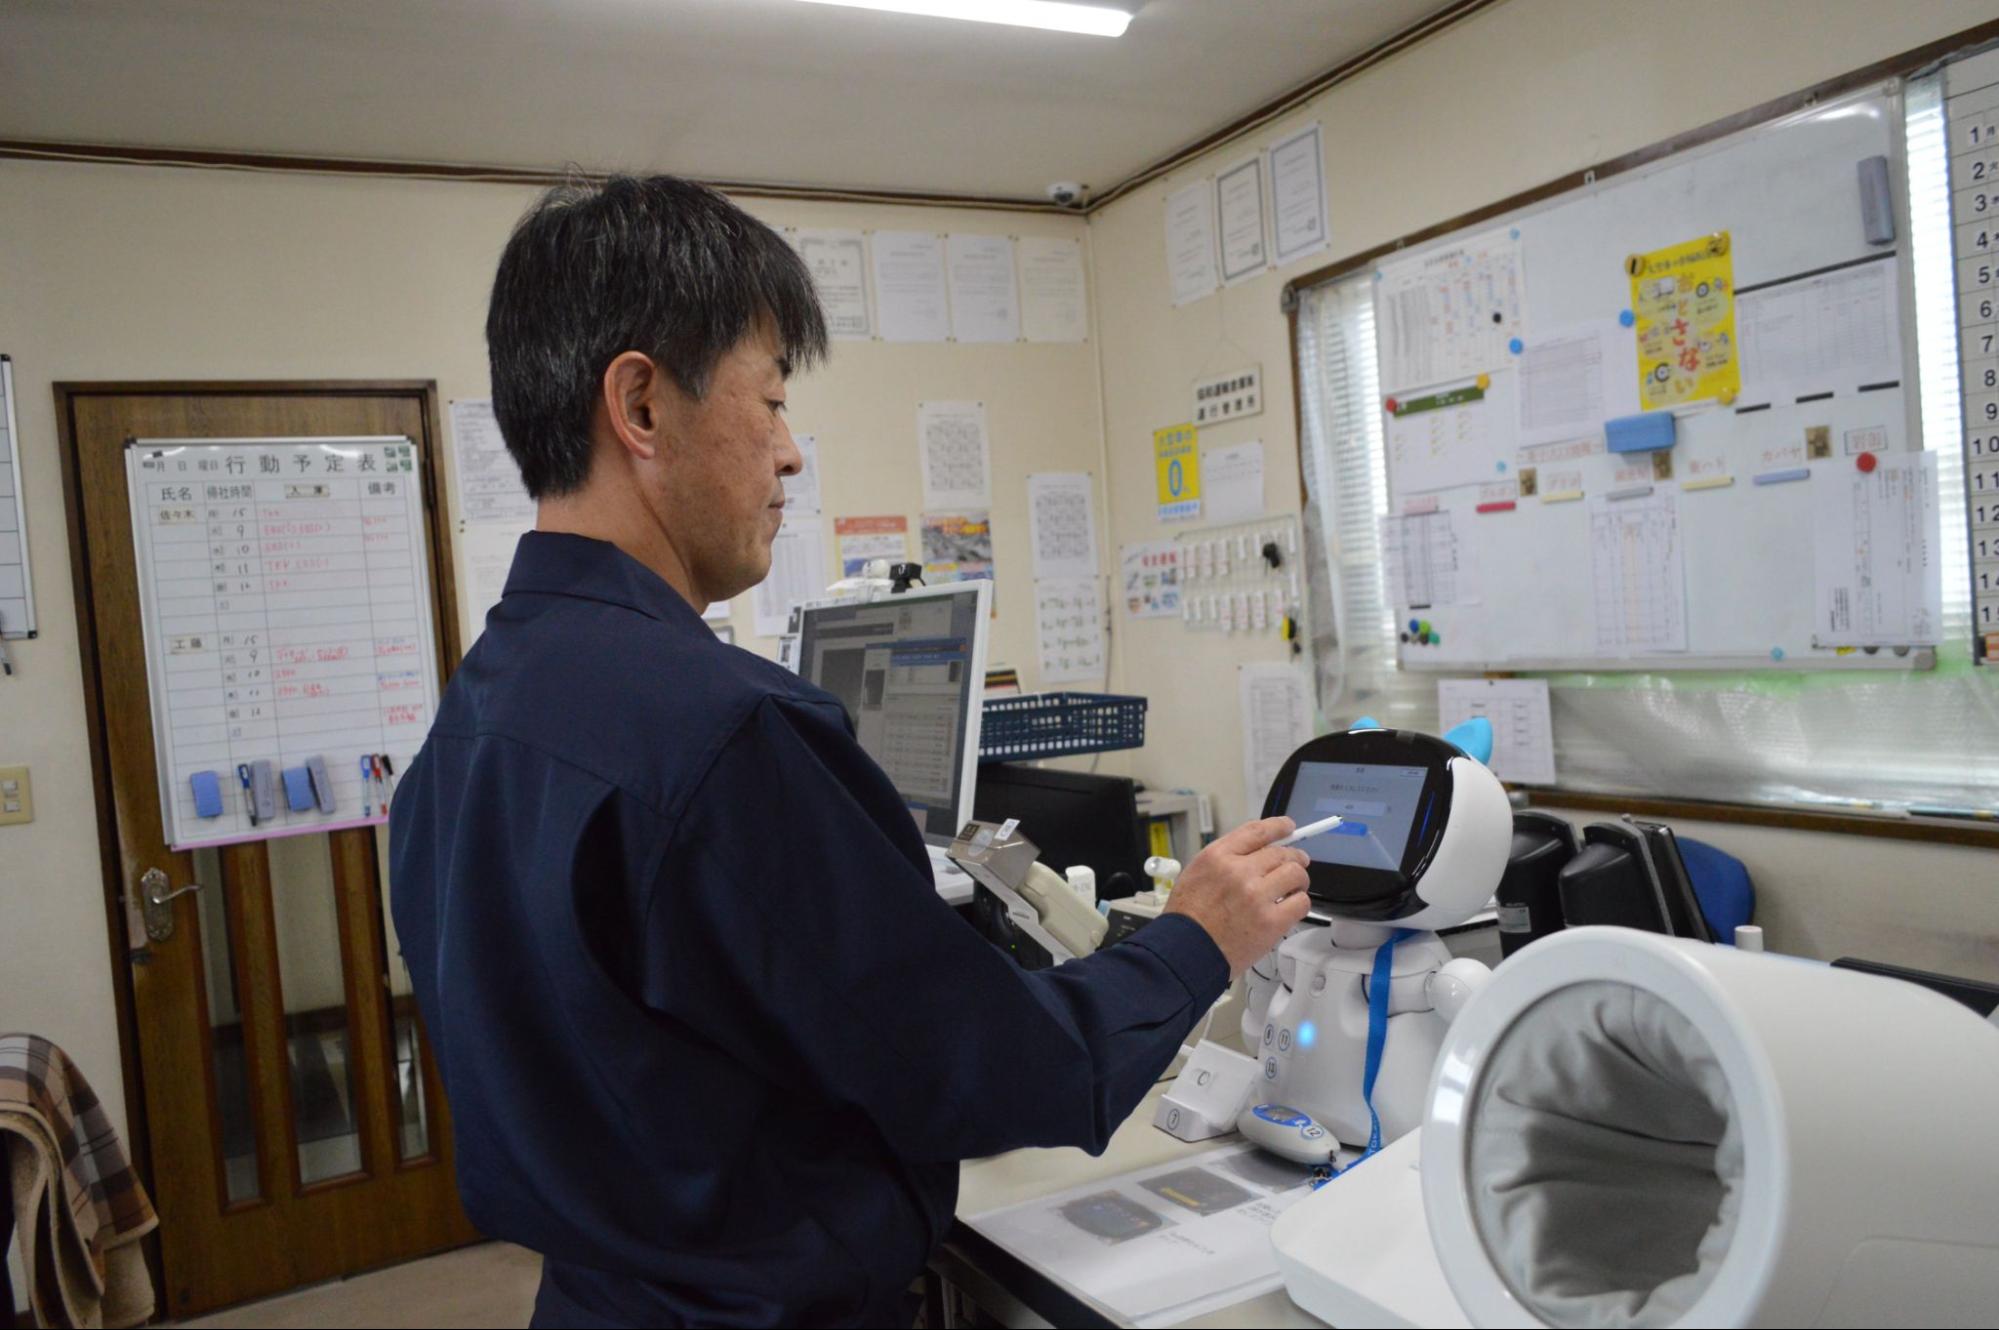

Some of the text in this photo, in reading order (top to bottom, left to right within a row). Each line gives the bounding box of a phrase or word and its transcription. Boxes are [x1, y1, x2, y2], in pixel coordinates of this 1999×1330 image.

[1970, 126, 1979, 144] 1
[1972, 162, 1985, 180] 2
[1975, 194, 1987, 212] 3
[1976, 232, 1989, 249] 4
[1978, 266, 1990, 284] 5
[1980, 300, 1992, 318] 6
[1981, 335, 1994, 353] 7
[1984, 369, 1996, 387] 8
[1985, 403, 1998, 420] 9
[225, 453, 376, 475] 行動予定表
[161, 487, 192, 501] 氏名
